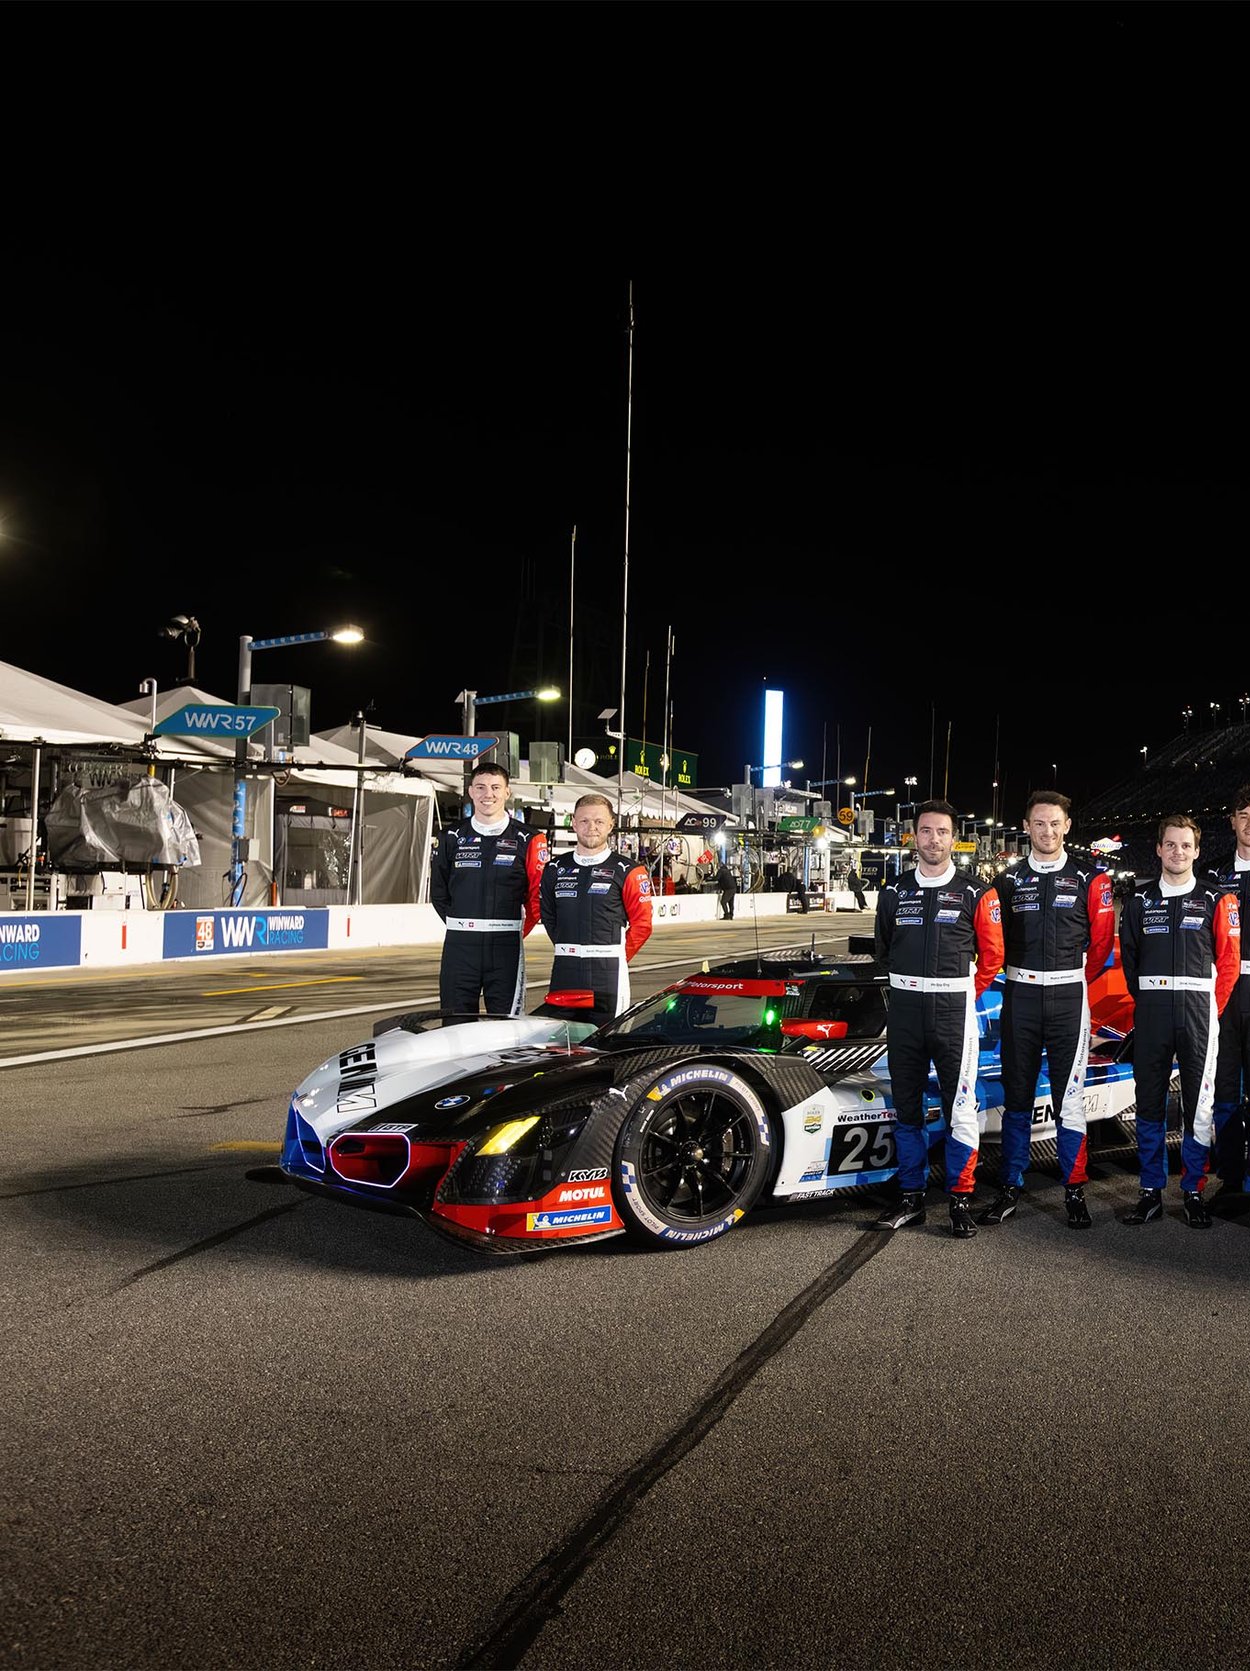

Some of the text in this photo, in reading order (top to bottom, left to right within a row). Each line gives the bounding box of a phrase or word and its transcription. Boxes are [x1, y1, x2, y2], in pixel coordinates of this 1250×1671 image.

[235, 715, 257, 731] 57
[463, 743, 479, 755] 48
[634, 765, 650, 776] ROLEX
[678, 773, 691, 784] ROLEX
[703, 817, 717, 828] 99
[839, 810, 853, 821] 59
[800, 820, 811, 828] 77
[269, 916, 304, 931] WINWARD
[197, 922, 213, 941] 48
[269, 930, 304, 945] RACING
[0, 943, 40, 961] CING
[1077, 1028, 1087, 1067] Motorsport
[670, 1069, 728, 1087] MICHELIN
[838, 1111, 897, 1123] WeatherTec
[1032, 1104, 1055, 1125] EN
[838, 1125, 894, 1171] 25
[569, 1168, 608, 1182] KYB
[559, 1187, 605, 1202] MOTUL
[552, 1211, 605, 1224] MICHELIN
[666, 1222, 725, 1241] MICHELIN
